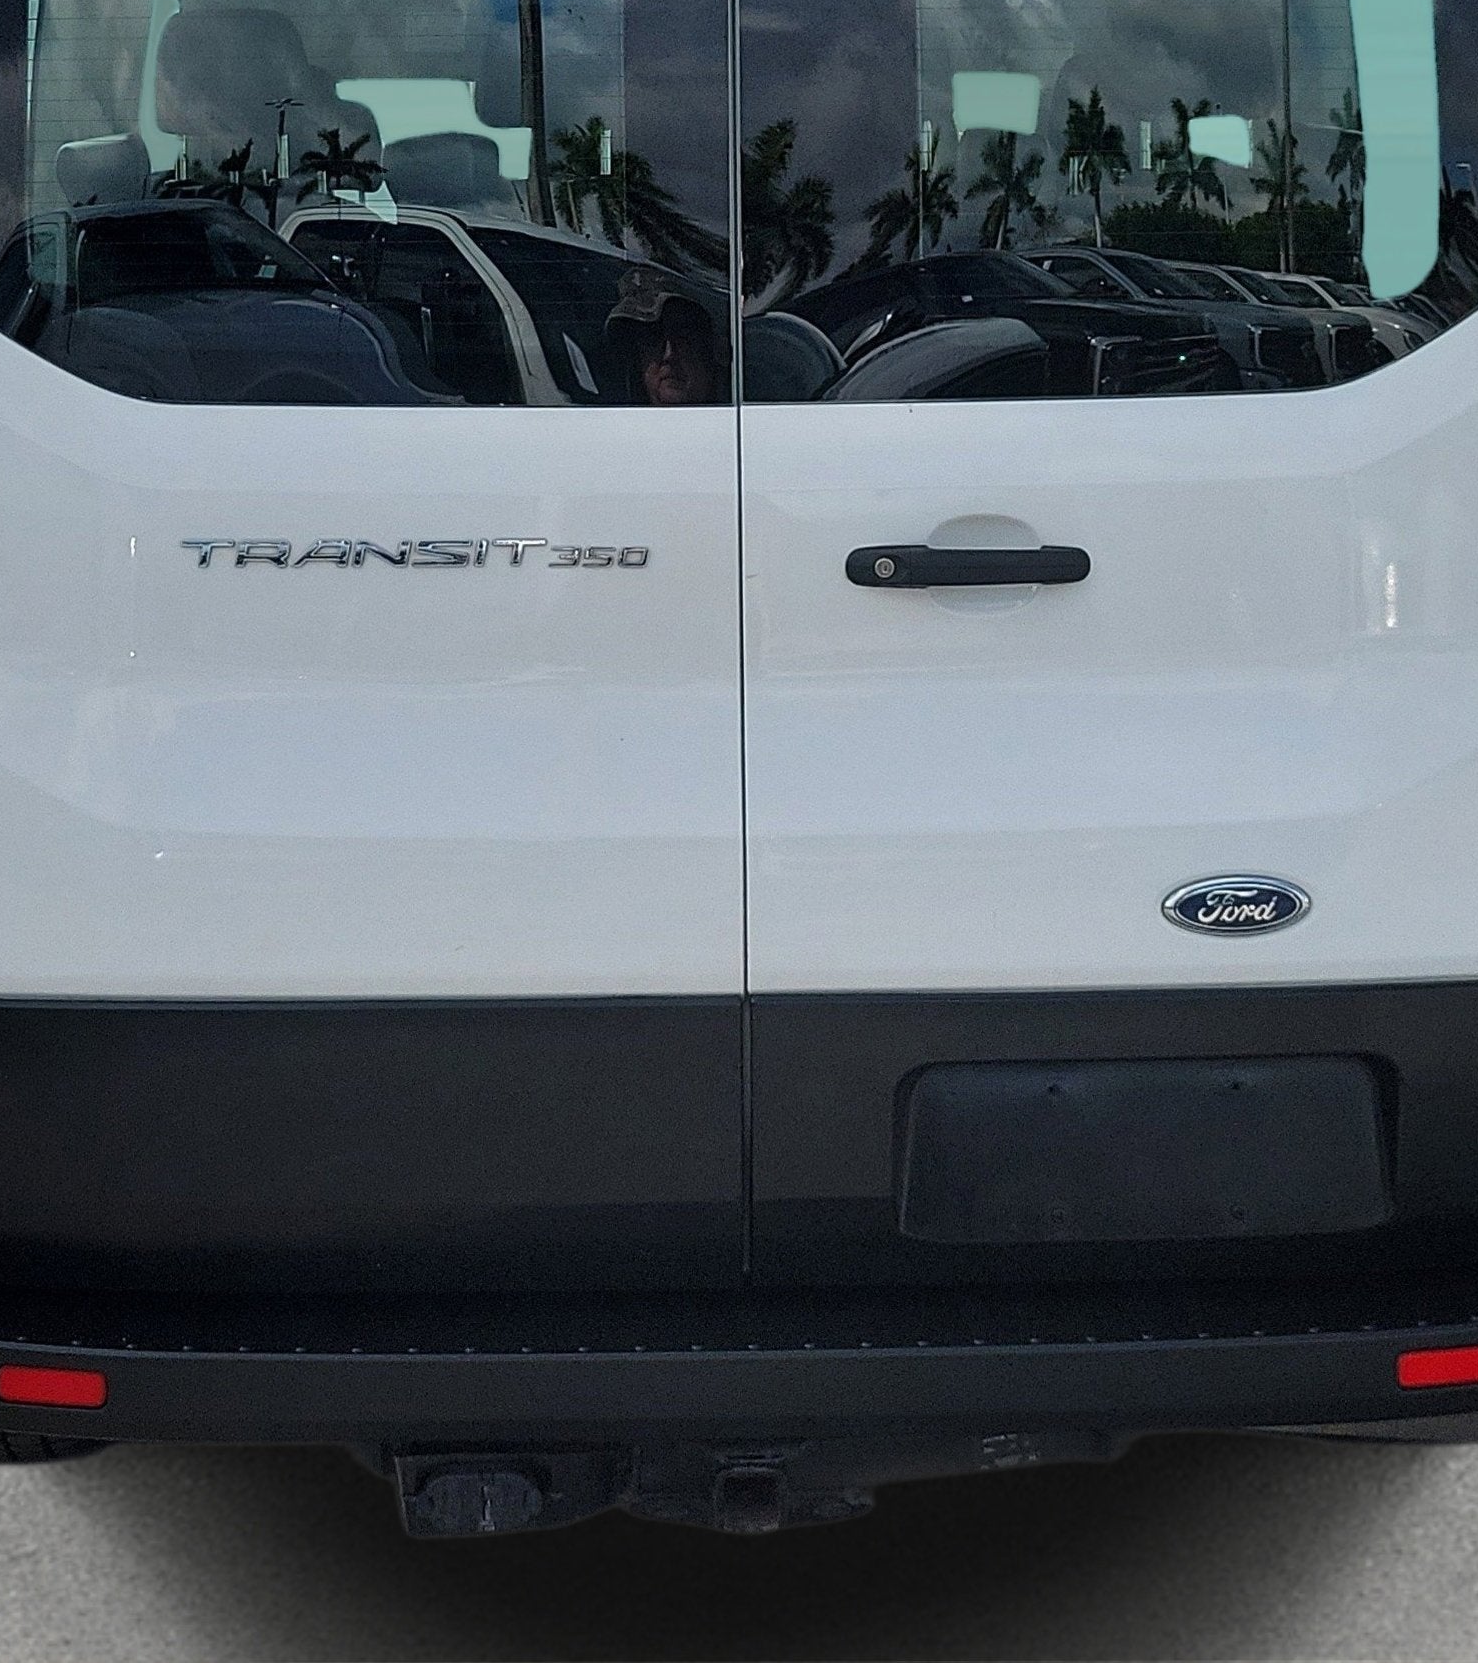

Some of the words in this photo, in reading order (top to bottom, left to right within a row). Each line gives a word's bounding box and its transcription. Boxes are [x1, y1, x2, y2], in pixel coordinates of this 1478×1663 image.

[181, 539, 548, 568] TRANSIT
[547, 544, 649, 568] 350
[1197, 889, 1278, 923] Ford
